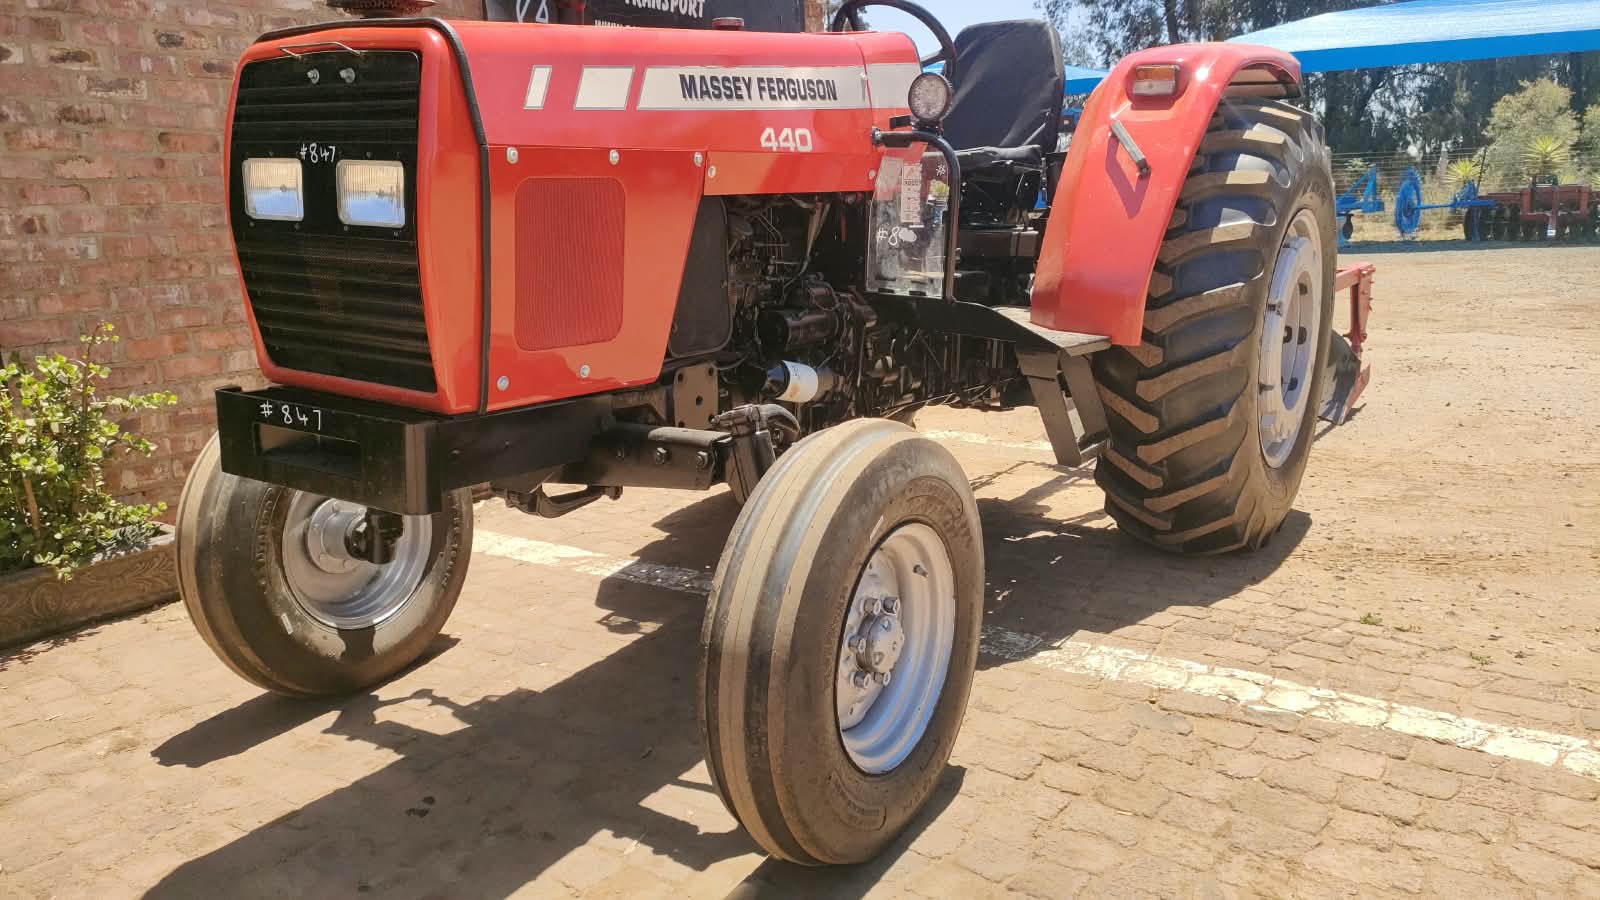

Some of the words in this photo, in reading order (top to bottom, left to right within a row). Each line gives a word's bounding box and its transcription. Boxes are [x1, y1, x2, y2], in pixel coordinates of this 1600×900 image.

[624, 0, 704, 18] ANSPORT
[679, 73, 751, 101] MASSEY
[757, 76, 838, 101] FERGUSON
[760, 127, 813, 152] 440
[300, 142, 336, 163] #847
